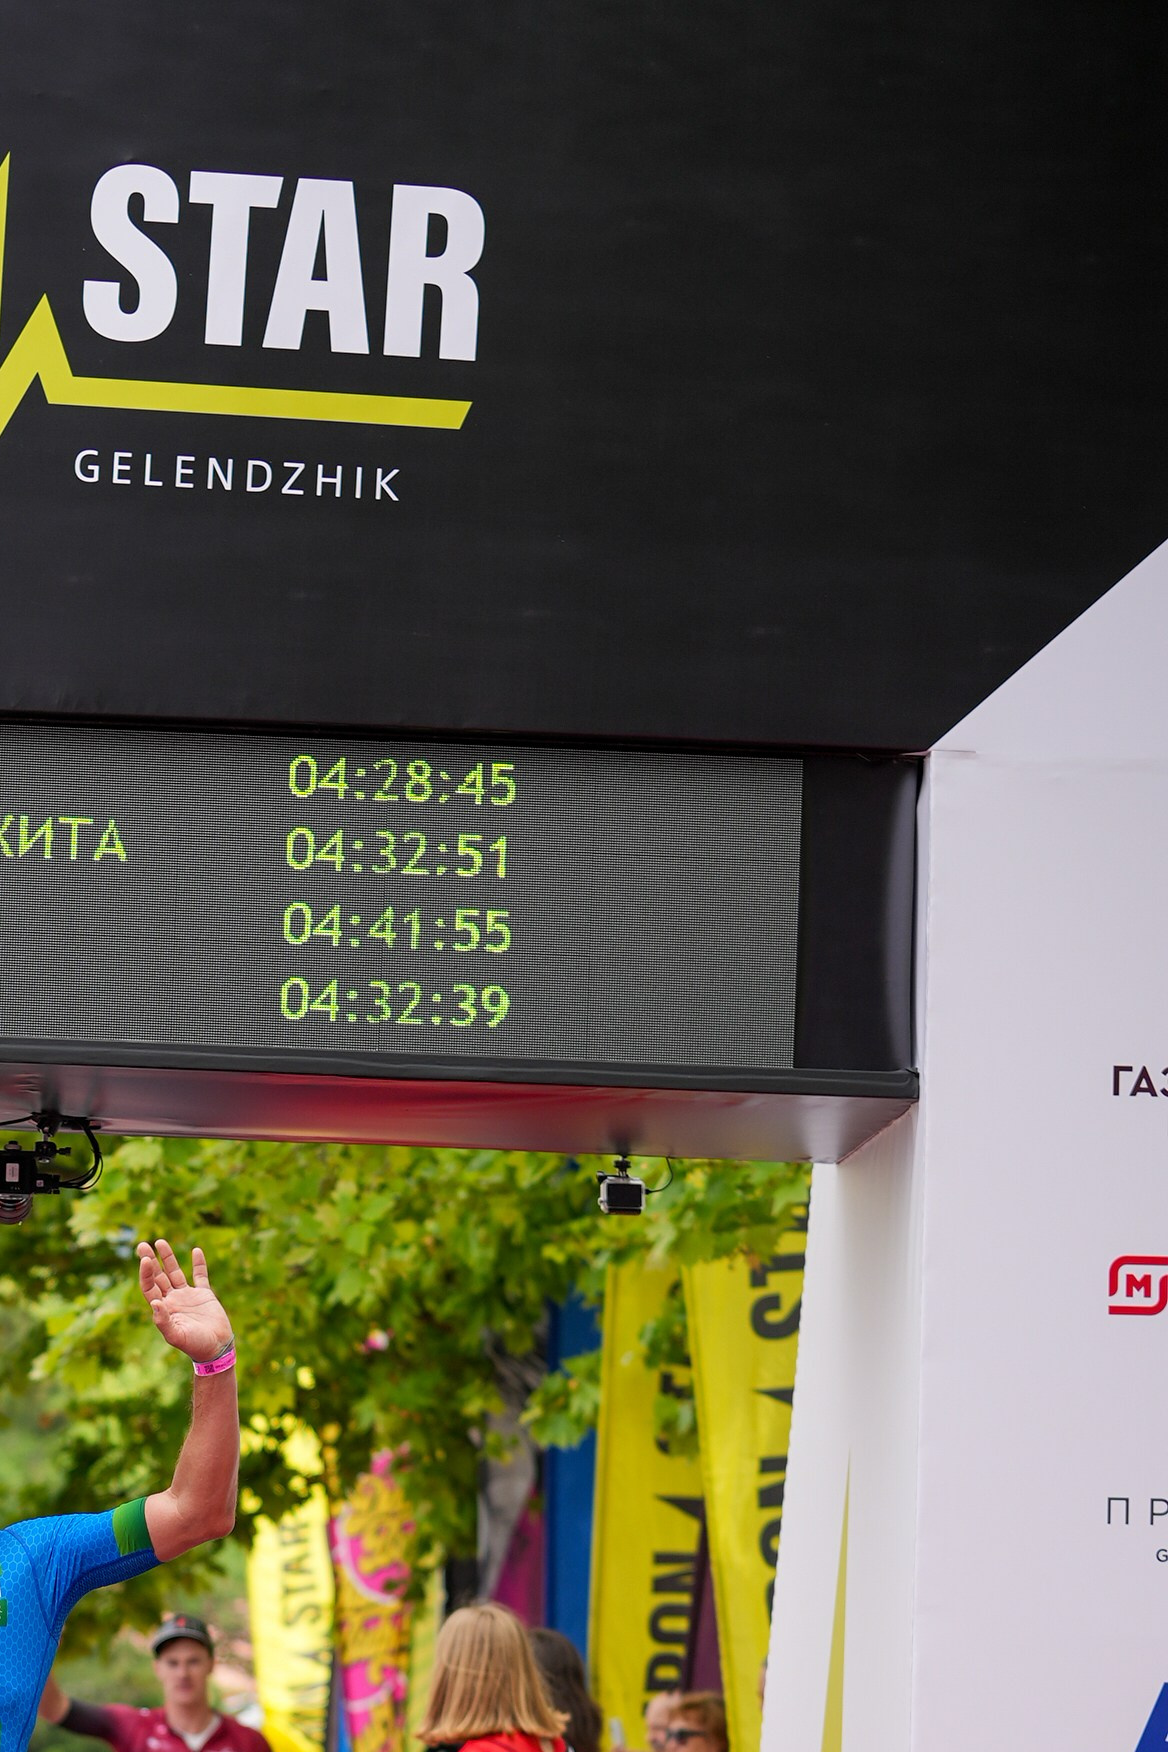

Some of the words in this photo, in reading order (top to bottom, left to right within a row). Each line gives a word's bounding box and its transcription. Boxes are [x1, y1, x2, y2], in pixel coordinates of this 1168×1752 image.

[82, 163, 486, 362] STAR
[73, 449, 403, 502] GELENDZHIK
[288, 755, 517, 806] 04:28:45
[285, 827, 508, 878] 04:32:51
[283, 902, 512, 953] 04:41:55
[280, 977, 511, 1028] 04:32:39
